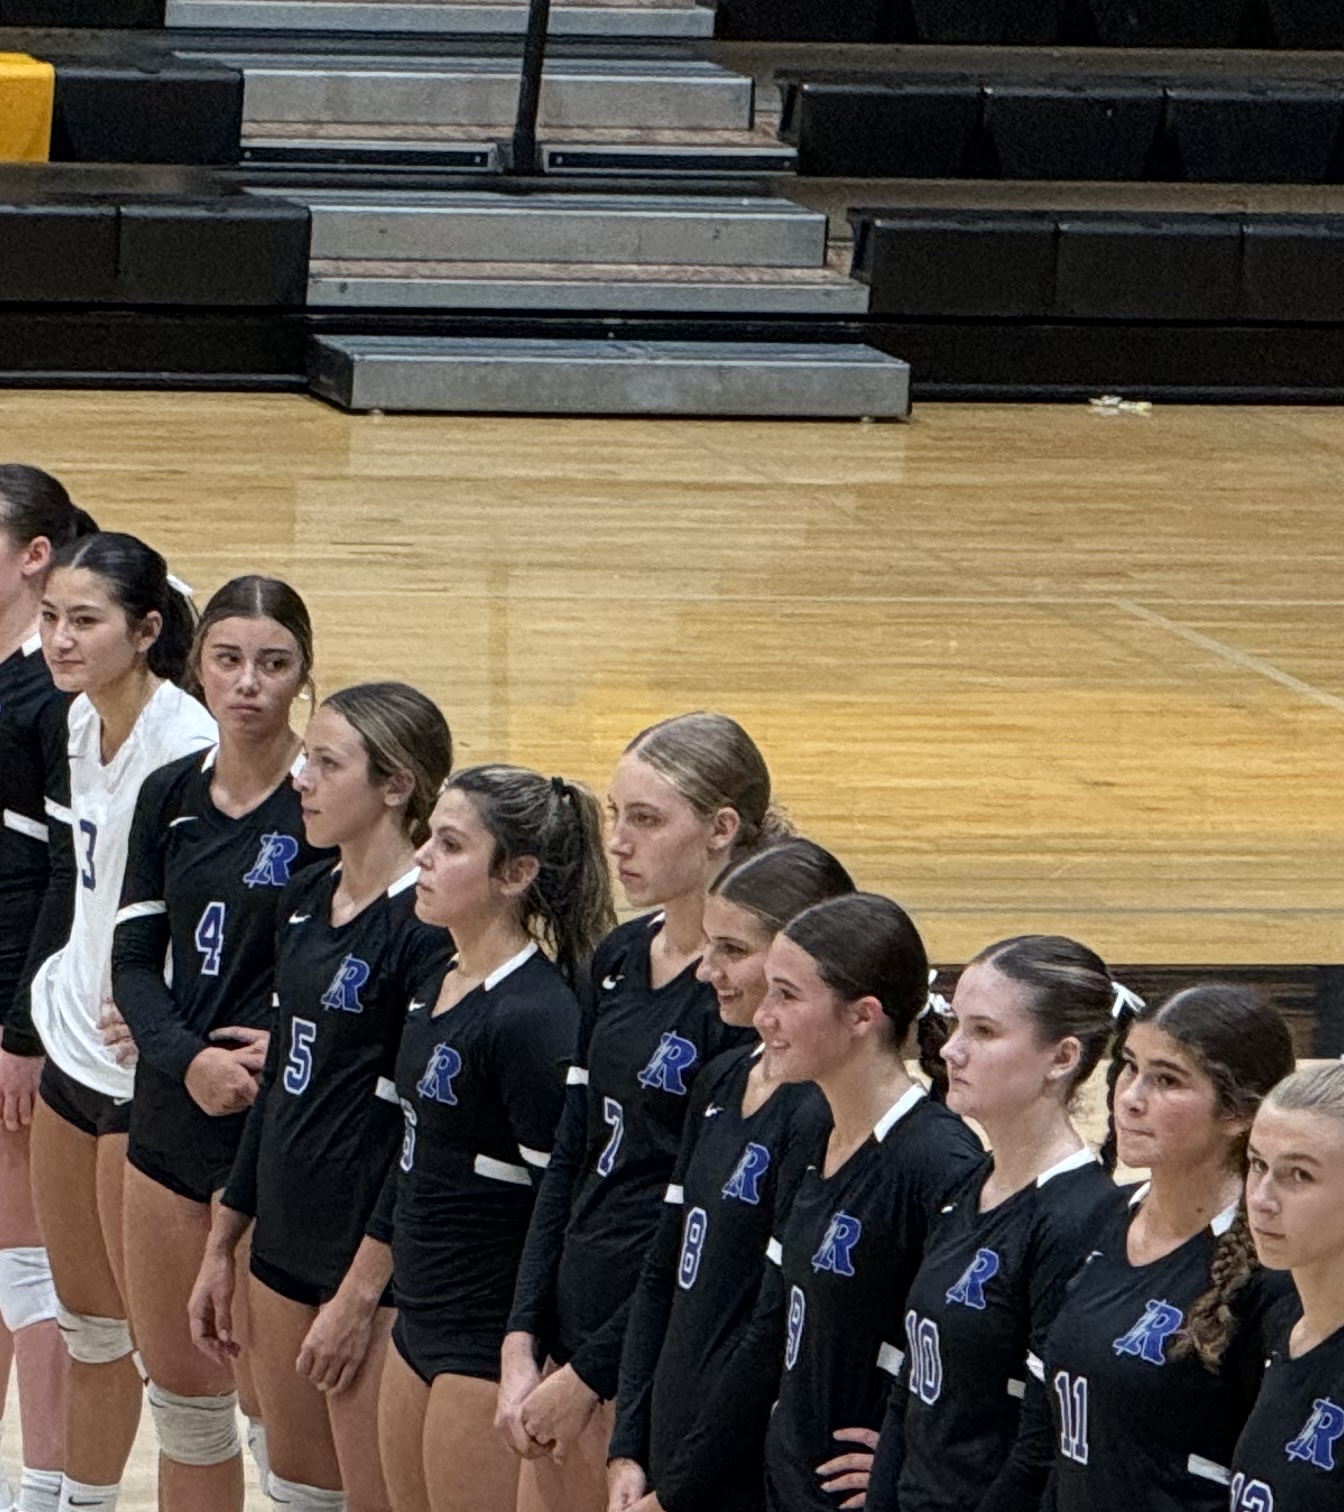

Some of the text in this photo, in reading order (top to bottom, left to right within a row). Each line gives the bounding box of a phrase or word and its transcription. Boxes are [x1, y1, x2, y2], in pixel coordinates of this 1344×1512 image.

[79, 819, 97, 892] 3
[243, 831, 299, 888] R
[196, 901, 226, 976] 4
[321, 953, 370, 1013] R
[284, 1016, 316, 1095] 5
[417, 1041, 462, 1106] R
[637, 1030, 698, 1095] R
[596, 1096, 624, 1177] 7
[722, 1141, 771, 1205] R
[678, 1206, 707, 1290] 8
[811, 1210, 862, 1277] R
[946, 1247, 999, 1310] R
[785, 1285, 806, 1371] 9
[905, 1309, 942, 1406] 10
[1113, 1299, 1184, 1367] R
[1055, 1370, 1089, 1465] 11
